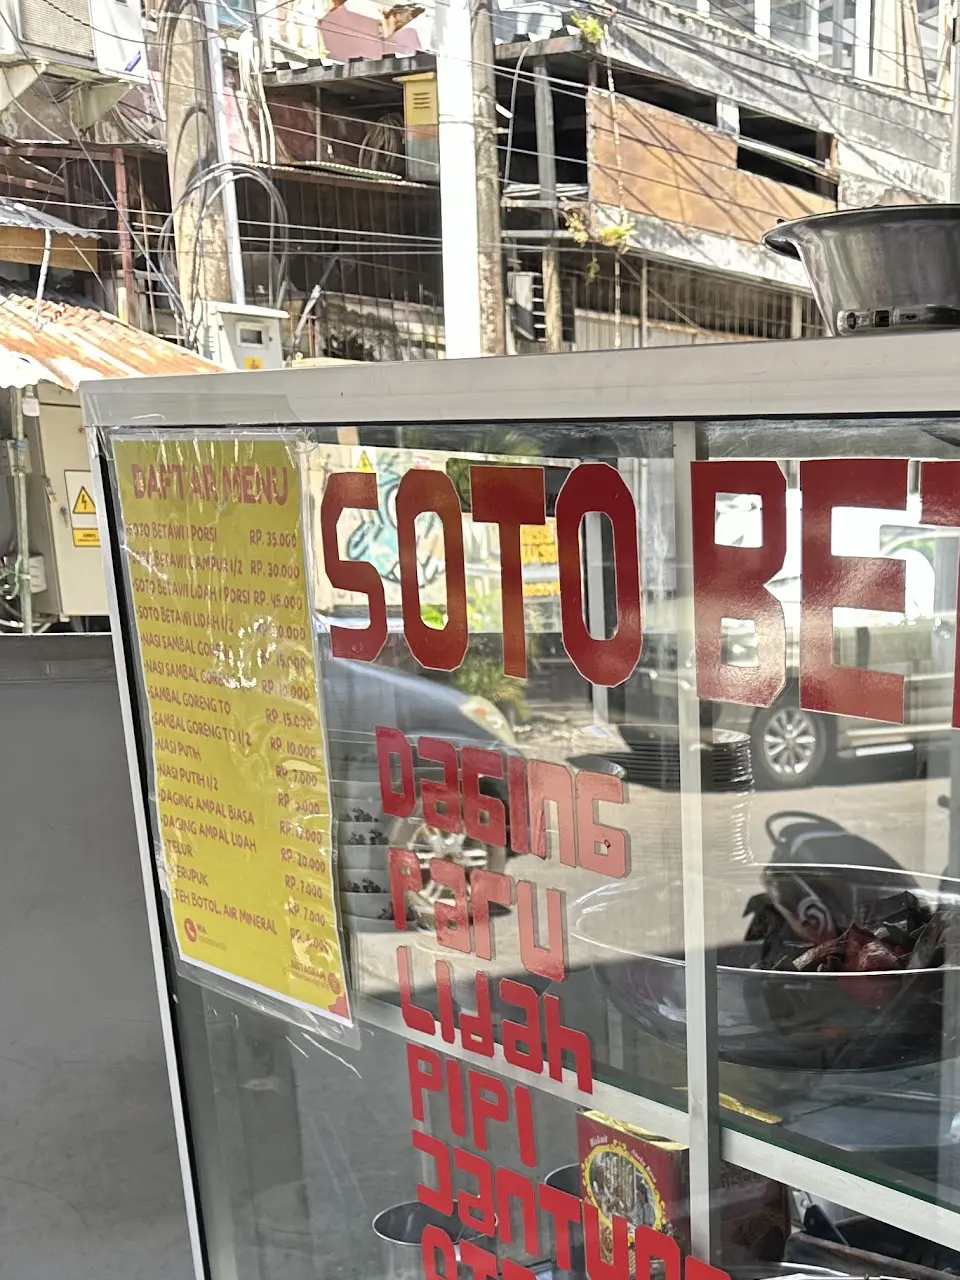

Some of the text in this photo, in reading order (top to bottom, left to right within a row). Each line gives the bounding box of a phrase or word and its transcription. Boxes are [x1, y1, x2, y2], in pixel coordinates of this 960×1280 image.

[131, 463, 289, 506] DAFTAR MENU
[151, 521, 185, 540] BETAWI
[191, 524, 217, 543] PORSI
[266, 531, 297, 549] 35.000
[267, 562, 300, 580] 30.000
[320, 462, 643, 688] SOTO
[157, 578, 189, 598] BETAWI
[224, 586, 251, 605] PORSI
[137, 605, 160, 622] SOTO
[161, 606, 192, 626] BETAWI
[193, 611, 219, 631] LIDAH
[142, 631, 161, 649] NASI
[161, 635, 196, 655] SAMBAL
[145, 658, 165, 676] NASI
[165, 662, 199, 683] SAMBAL
[149, 685, 182, 706] SAMBAL
[182, 692, 217, 713] GORENG
[218, 699, 232, 716] TO
[282, 711, 314, 730] 15.000
[153, 711, 186, 733] SAMBAL
[187, 719, 222, 741] GORENG
[222, 726, 237, 743] TO
[286, 740, 317, 760] 10.000
[157, 738, 177, 756] NASI
[178, 740, 202, 762] PUTIH
[158, 763, 179, 782] NASI
[180, 767, 206, 789] PUTIH
[159, 788, 194, 810] DAGING
[195, 796, 227, 819] AMPAL
[227, 804, 255, 825] BIASA
[162, 813, 198, 836] DAGING
[199, 822, 230, 846] AMPAL
[297, 852, 326, 874] 20.000
[166, 838, 194, 858] TELUR
[300, 880, 323, 900] 7.000
[172, 862, 209, 887] ERUPUK
[174, 887, 191, 907] TEH
[223, 903, 238, 921] AIR
[239, 908, 278, 936] MINERAL
